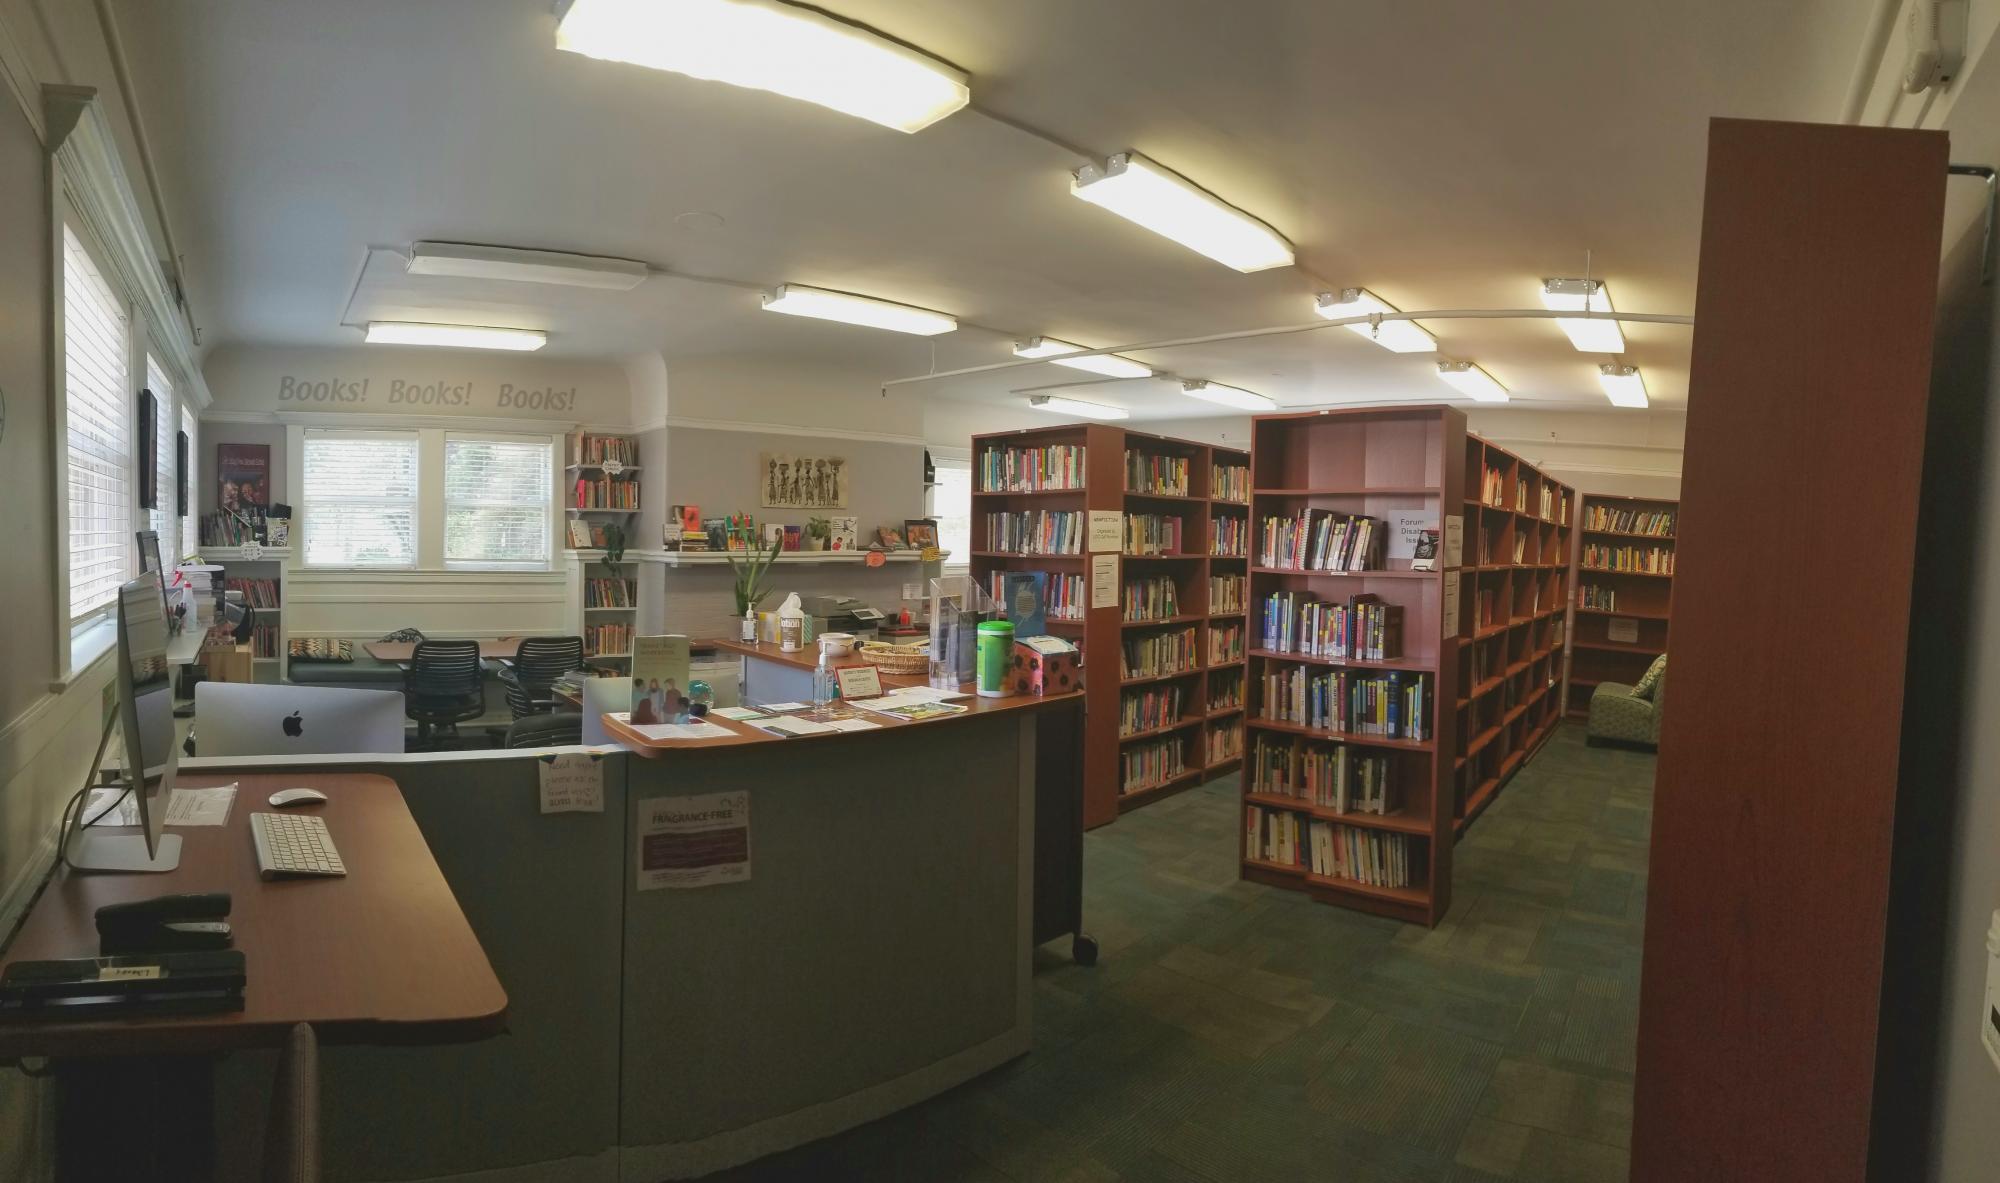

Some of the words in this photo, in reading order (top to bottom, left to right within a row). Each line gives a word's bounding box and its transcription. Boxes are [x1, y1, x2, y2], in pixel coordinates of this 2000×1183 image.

[278, 375, 369, 402] Books!
[388, 379, 474, 406] Books!
[497, 383, 578, 412] Books!
[780, 617, 800, 628] lotion
[651, 808, 734, 825] FRAGRANCE-FREE
